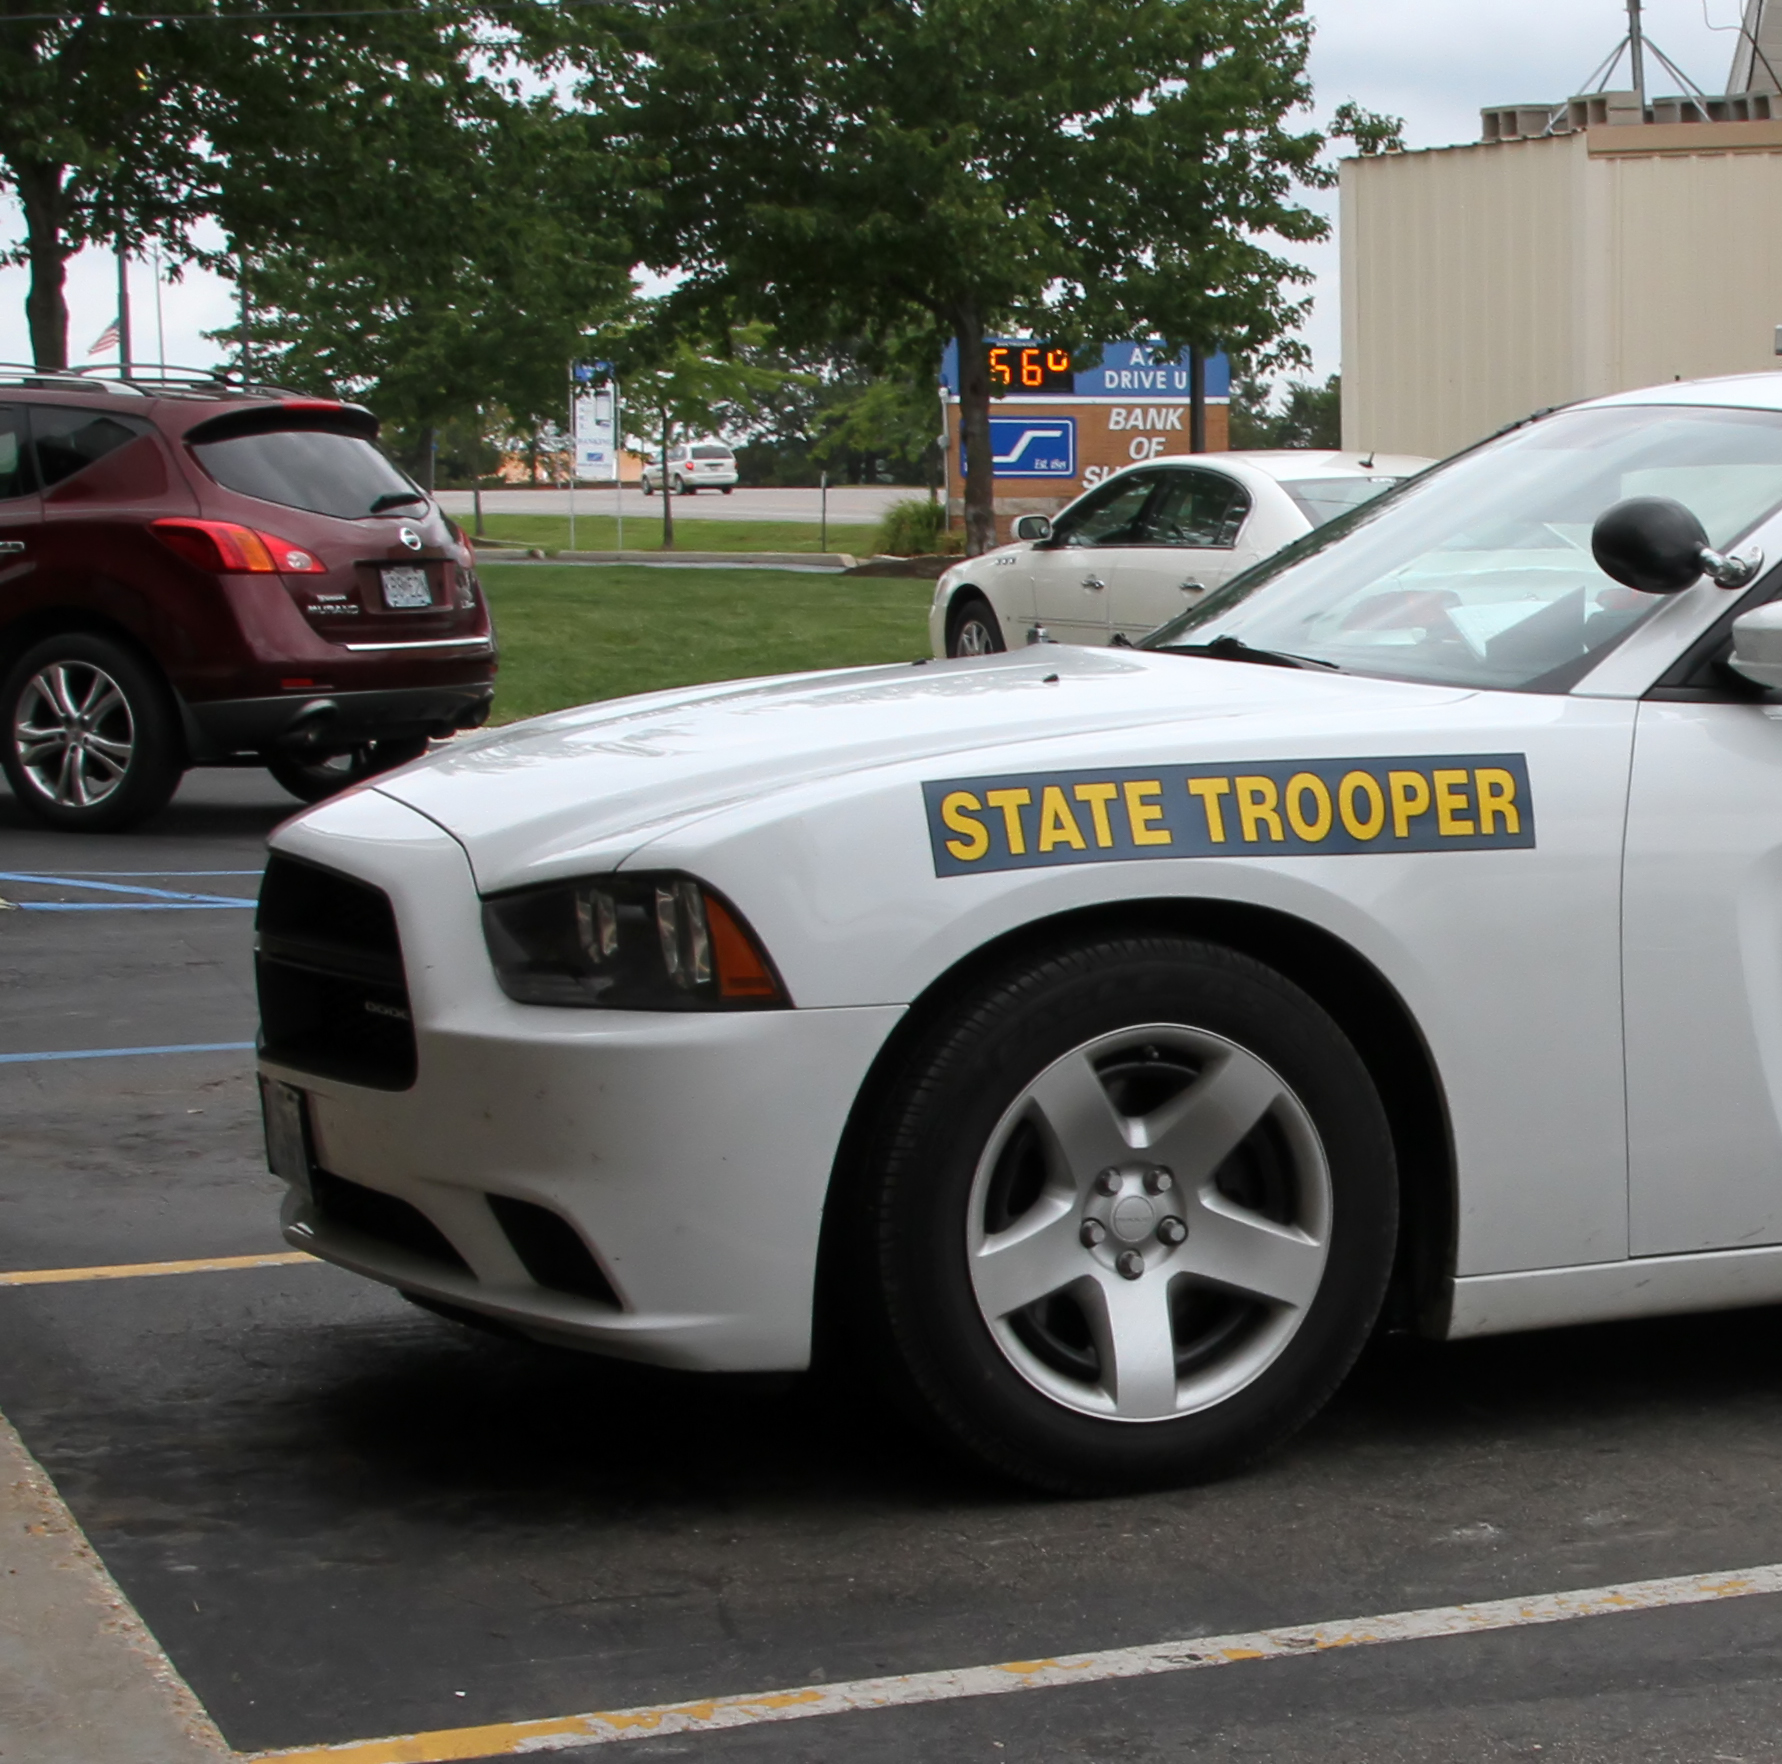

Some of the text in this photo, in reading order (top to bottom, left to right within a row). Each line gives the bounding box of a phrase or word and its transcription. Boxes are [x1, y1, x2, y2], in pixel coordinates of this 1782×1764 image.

[1104, 370, 1187, 390] DRIVE U
[1108, 407, 1185, 431] BANK
[1128, 436, 1166, 460] OF
[940, 766, 1521, 862] STATE TROOPER
